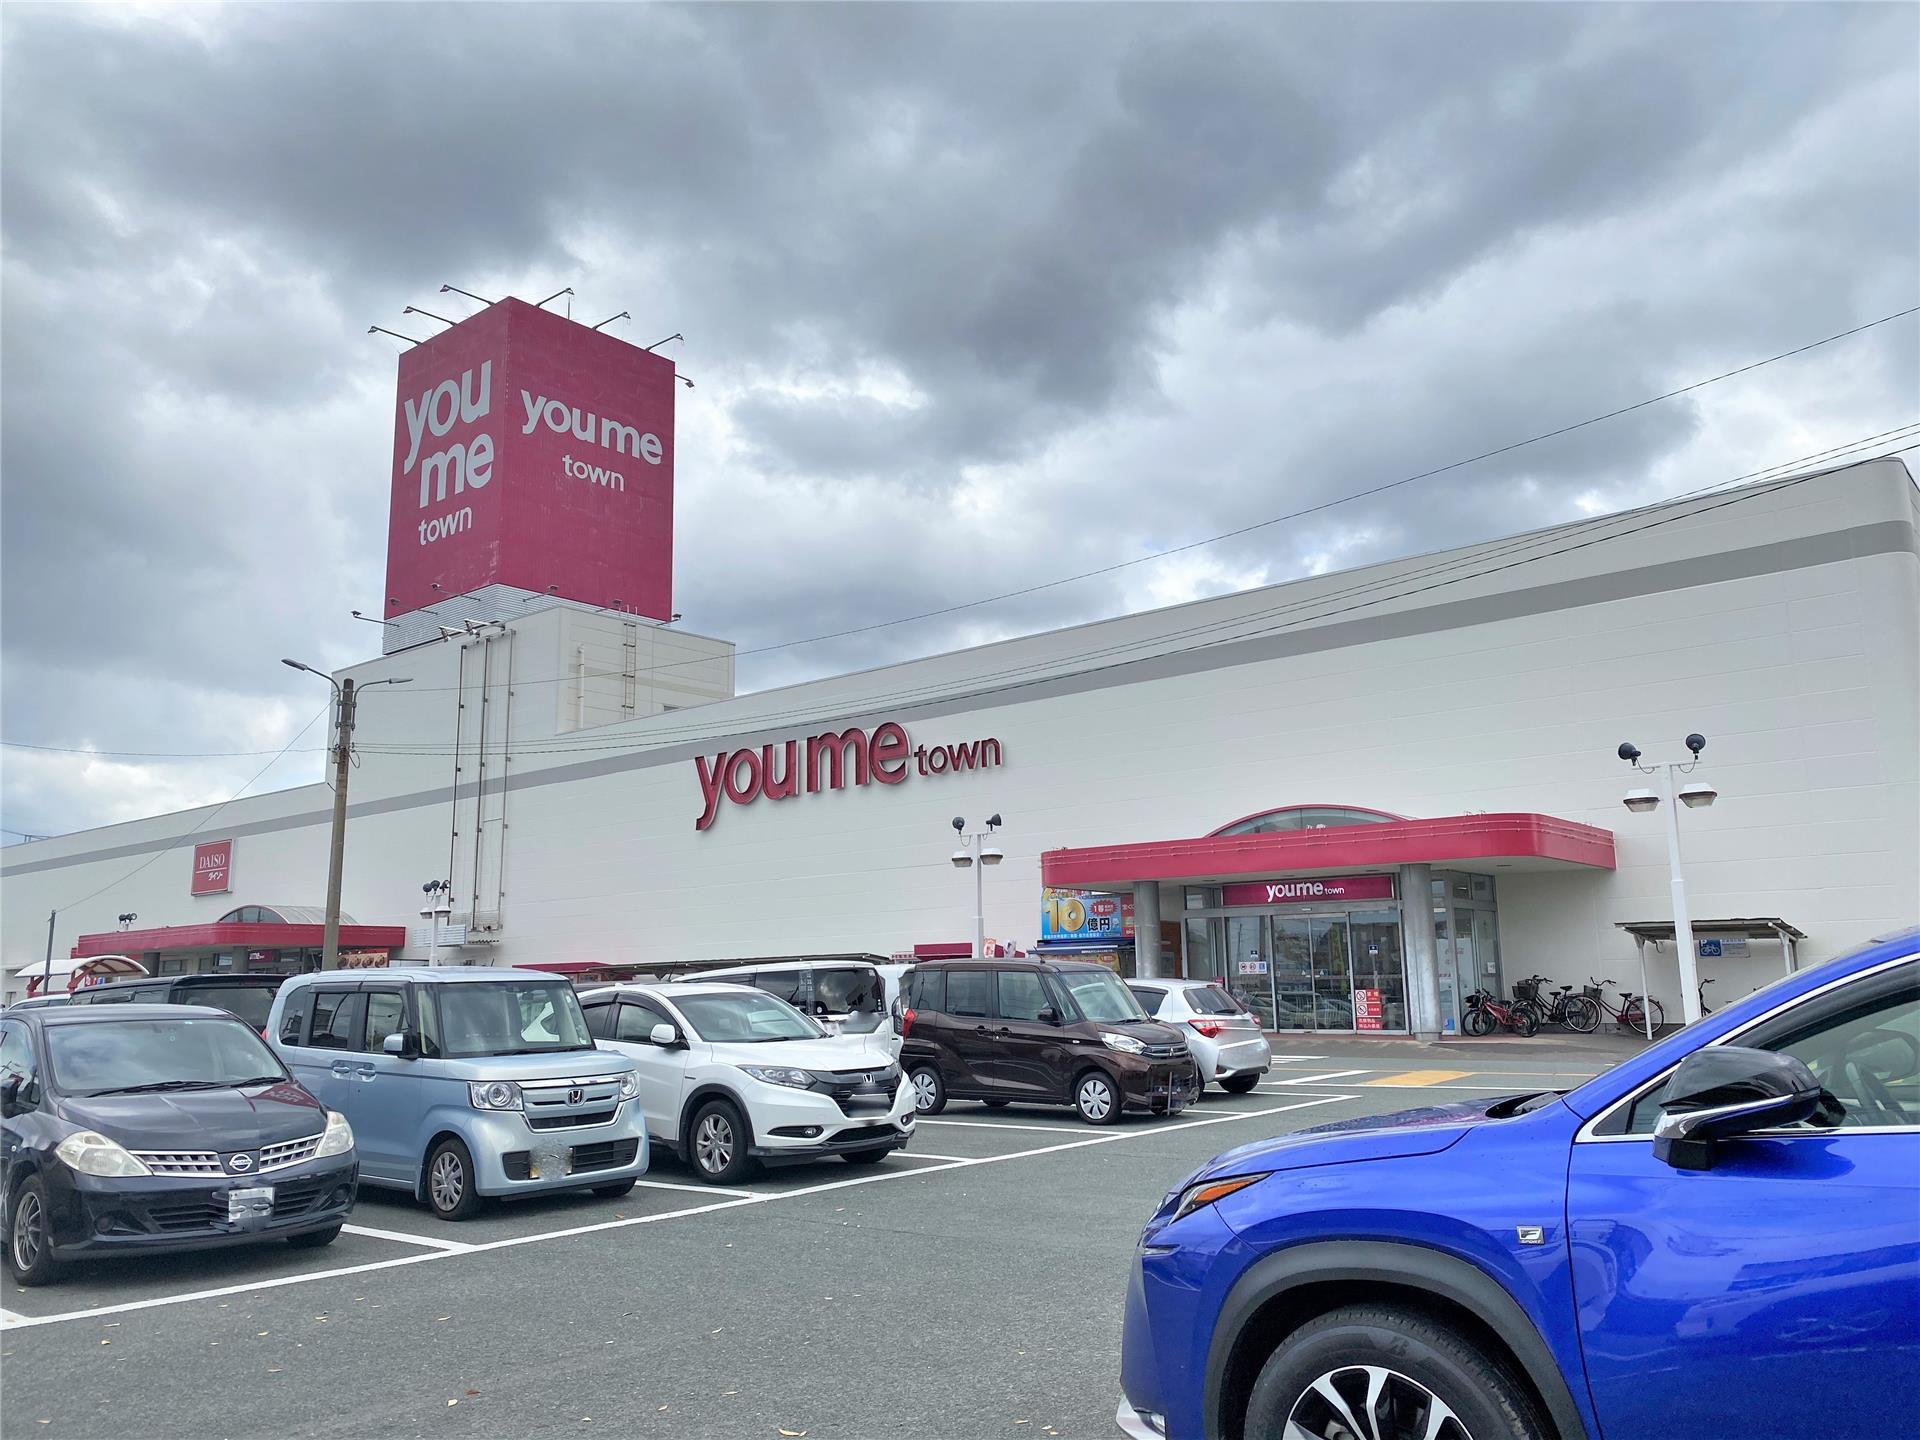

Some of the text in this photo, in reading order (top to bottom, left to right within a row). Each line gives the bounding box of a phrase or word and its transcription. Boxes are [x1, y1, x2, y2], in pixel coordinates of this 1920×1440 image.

[404, 360, 492, 475] you
[419, 433, 494, 509] me
[562, 454, 625, 491] town
[418, 506, 473, 545] town
[913, 737, 1003, 777] town
[199, 853, 225, 869] DAISO
[1324, 887, 1345, 895] town
